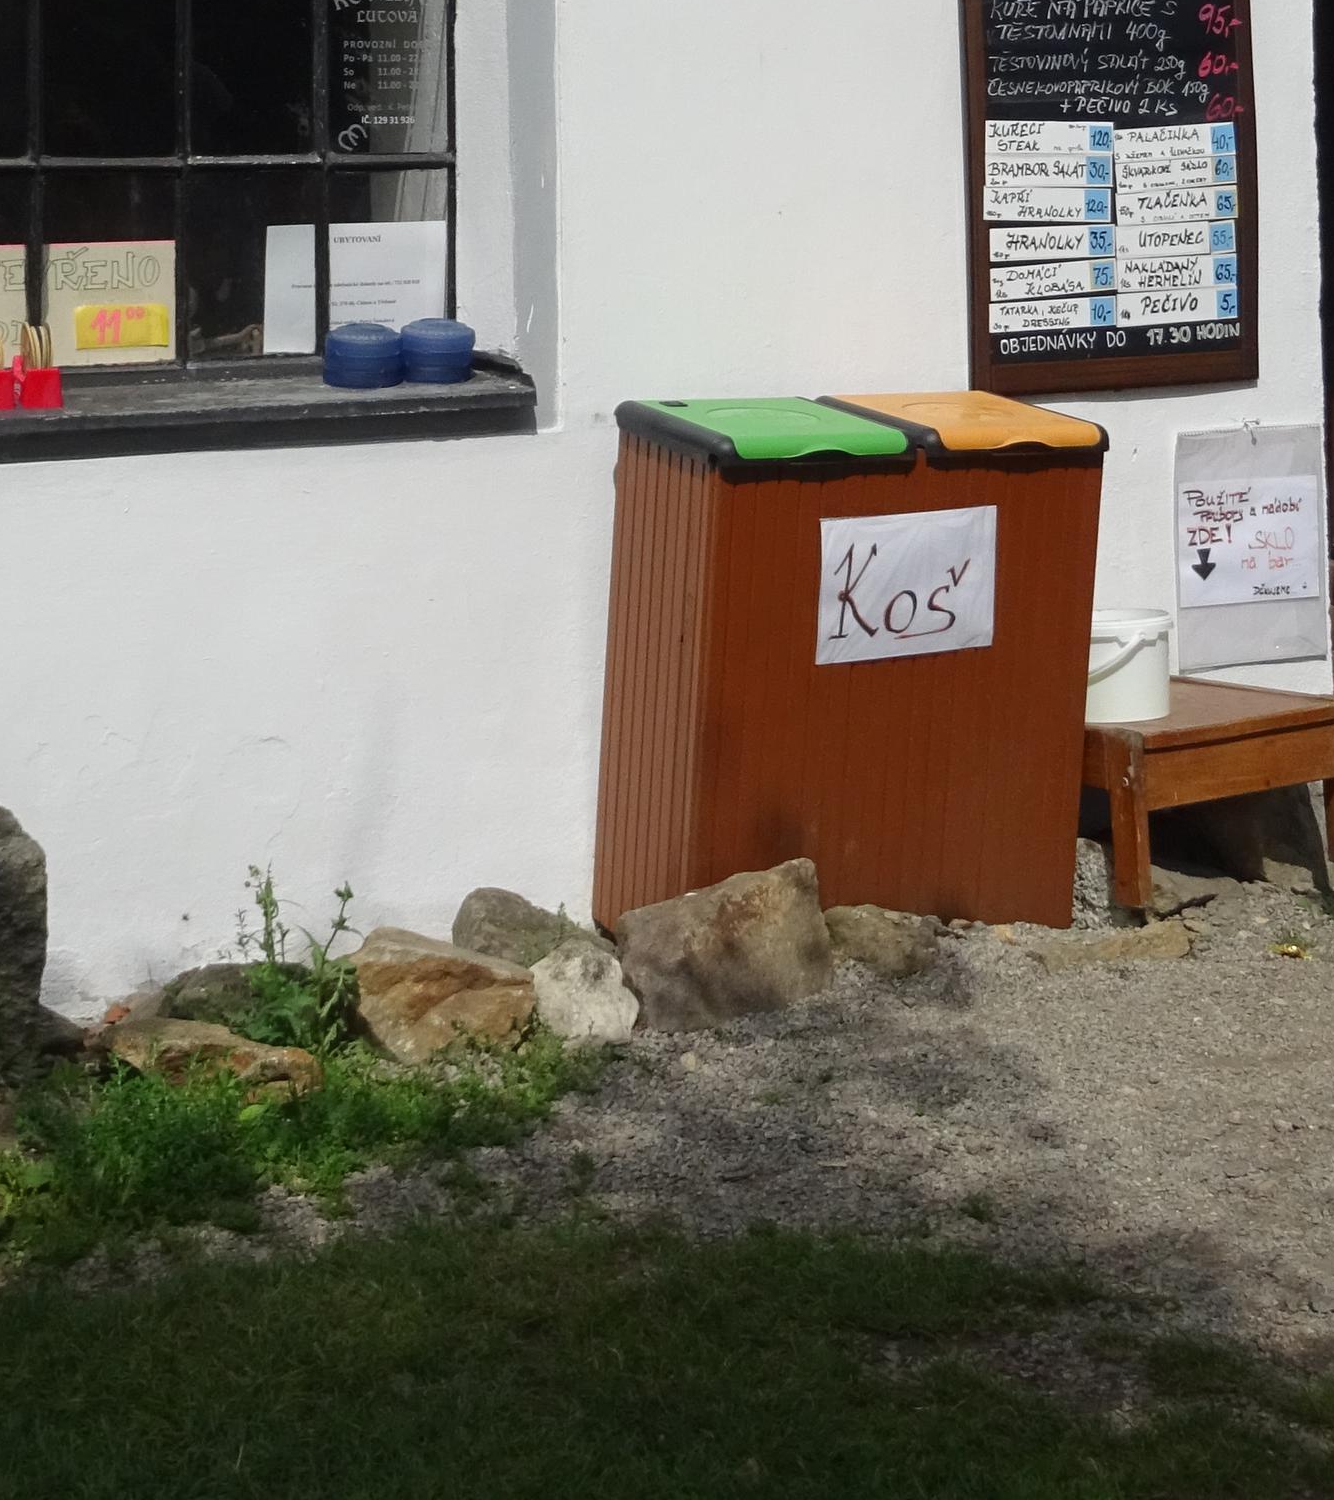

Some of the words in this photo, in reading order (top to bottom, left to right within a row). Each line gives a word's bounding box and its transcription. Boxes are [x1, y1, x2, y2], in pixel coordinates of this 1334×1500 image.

[997, 139, 1040, 152] STEAK
[1137, 189, 1208, 211] TLAČENKA
[1017, 205, 1082, 219] HRANOLKY
[1006, 232, 1084, 252] HRANOLKY
[1139, 228, 1204, 248] UTOPENEC
[1140, 292, 1199, 315] PEČIVO
[999, 329, 1097, 355] OBJEDNÁVKY
[1106, 330, 1126, 348] DO
[1196, 322, 1241, 341] HODIN
[1248, 526, 1295, 550] SKLO
[1241, 556, 1256, 570] na
[828, 542, 971, 640] Koš
